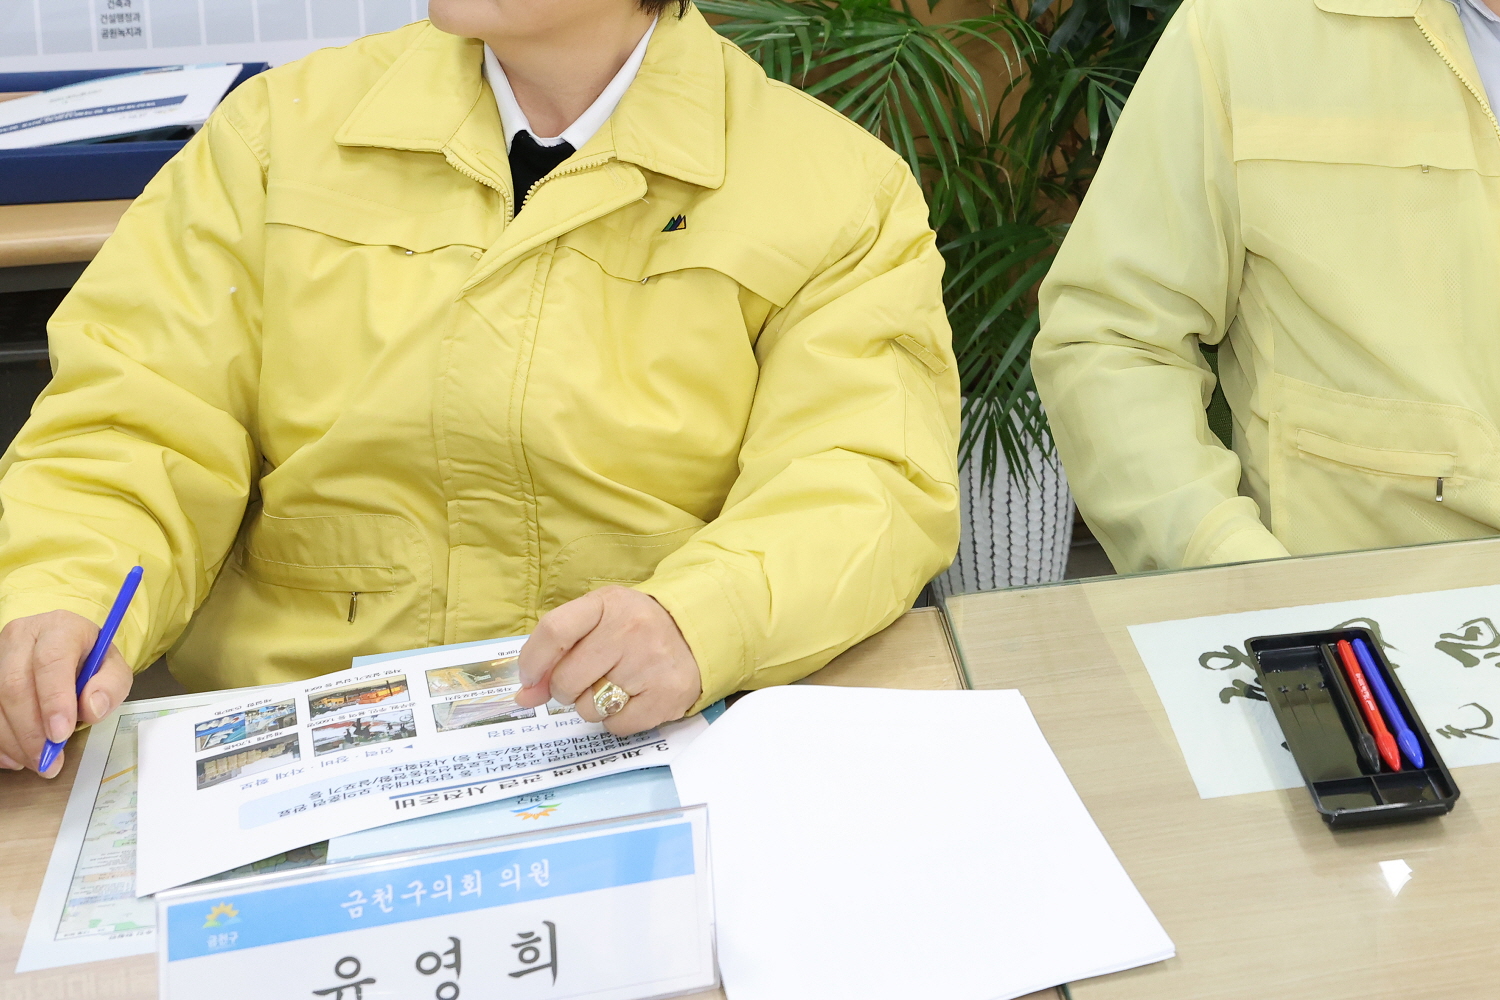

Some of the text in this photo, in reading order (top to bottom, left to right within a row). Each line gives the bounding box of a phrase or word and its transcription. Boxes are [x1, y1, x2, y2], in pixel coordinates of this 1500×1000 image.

[551, 748, 642, 778] 제설대책
[498, 773, 543, 791] 관련
[393, 785, 487, 812] 사전준비
[277, 804, 308, 818] 완료
[339, 858, 552, 920] 금천구의회 의원
[206, 932, 240, 950] 금천구
